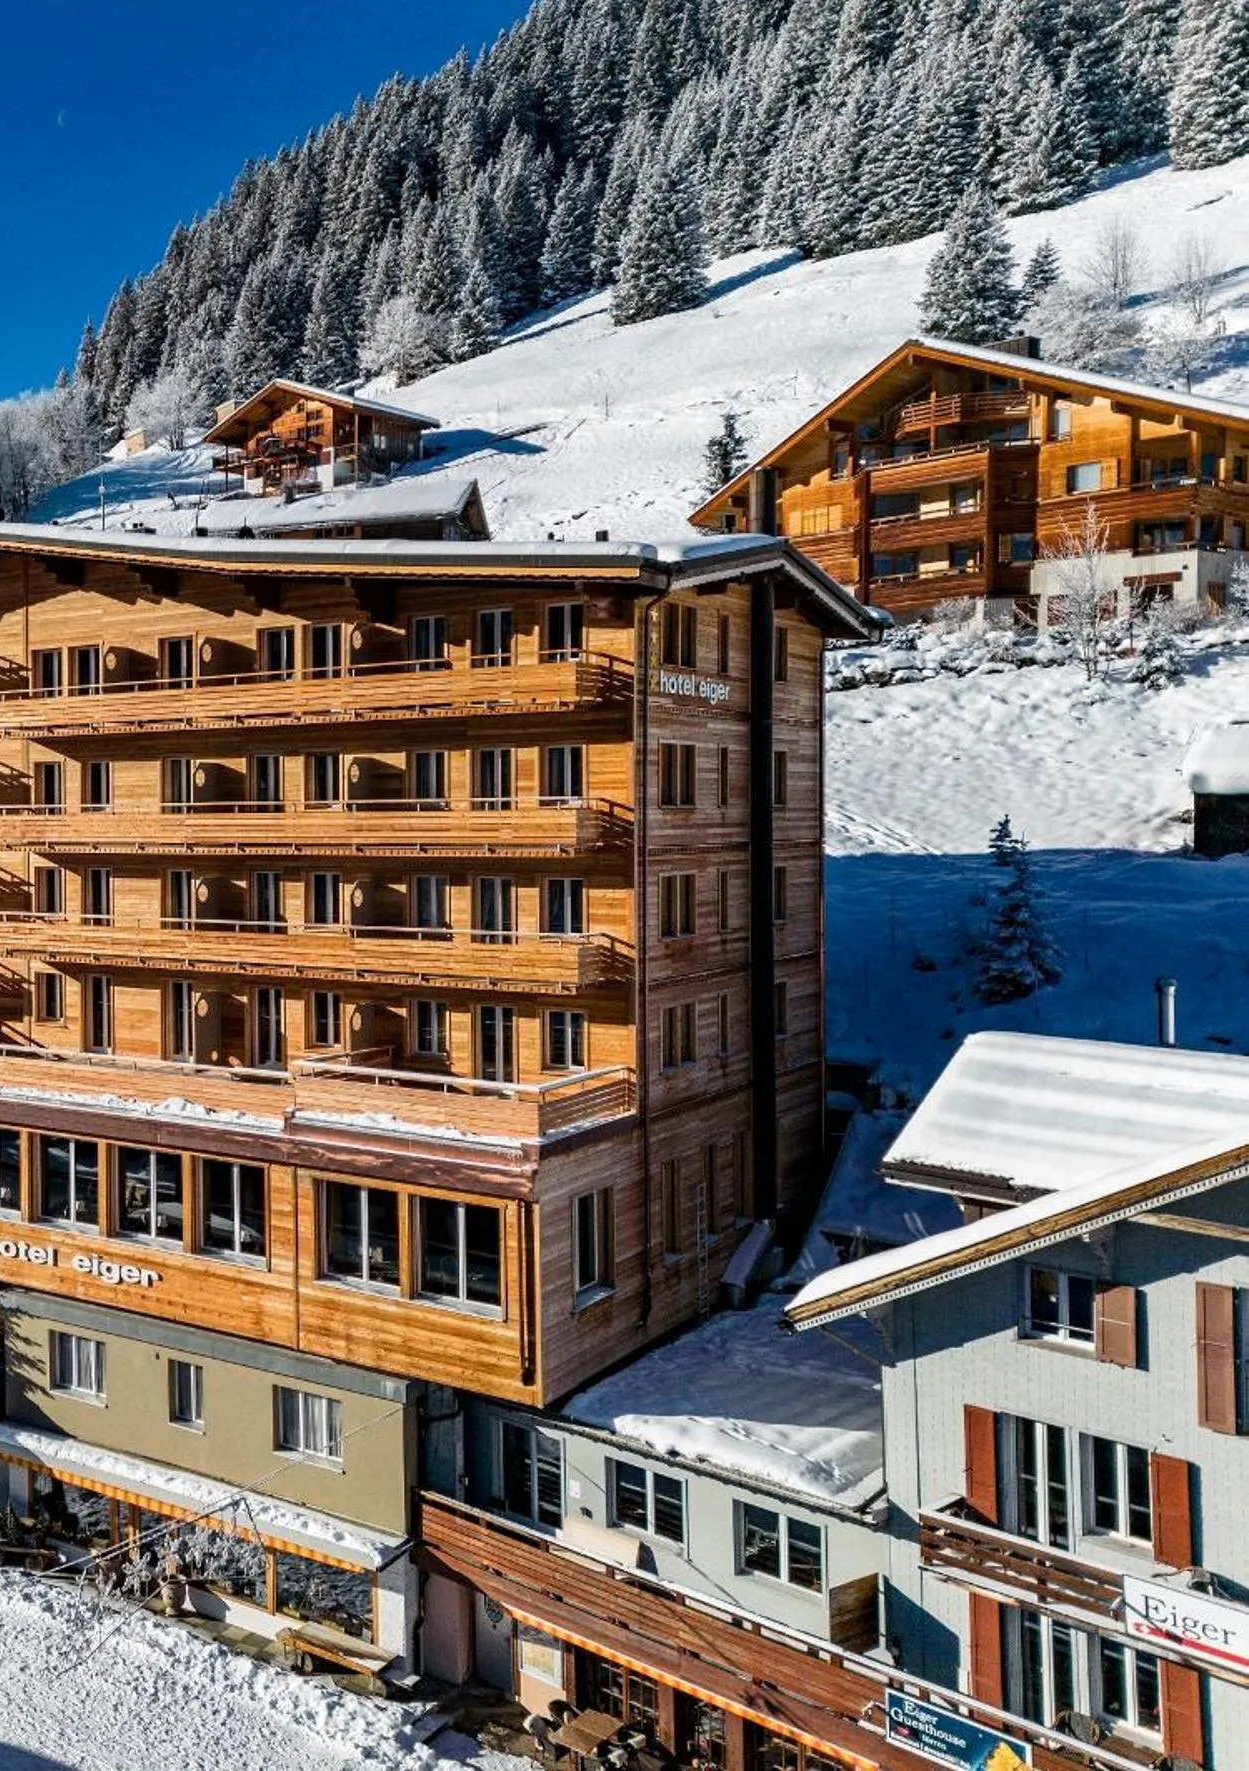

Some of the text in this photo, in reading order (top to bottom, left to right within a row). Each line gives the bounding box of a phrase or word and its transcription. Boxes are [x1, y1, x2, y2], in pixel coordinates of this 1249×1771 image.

[660, 669, 731, 705] hotel eiger
[71, 1253, 160, 1288] eiger
[1141, 1594, 1237, 1645] Eiger
[889, 1706, 967, 1749] Guesthouse
[903, 1700, 939, 1725] Eiger
